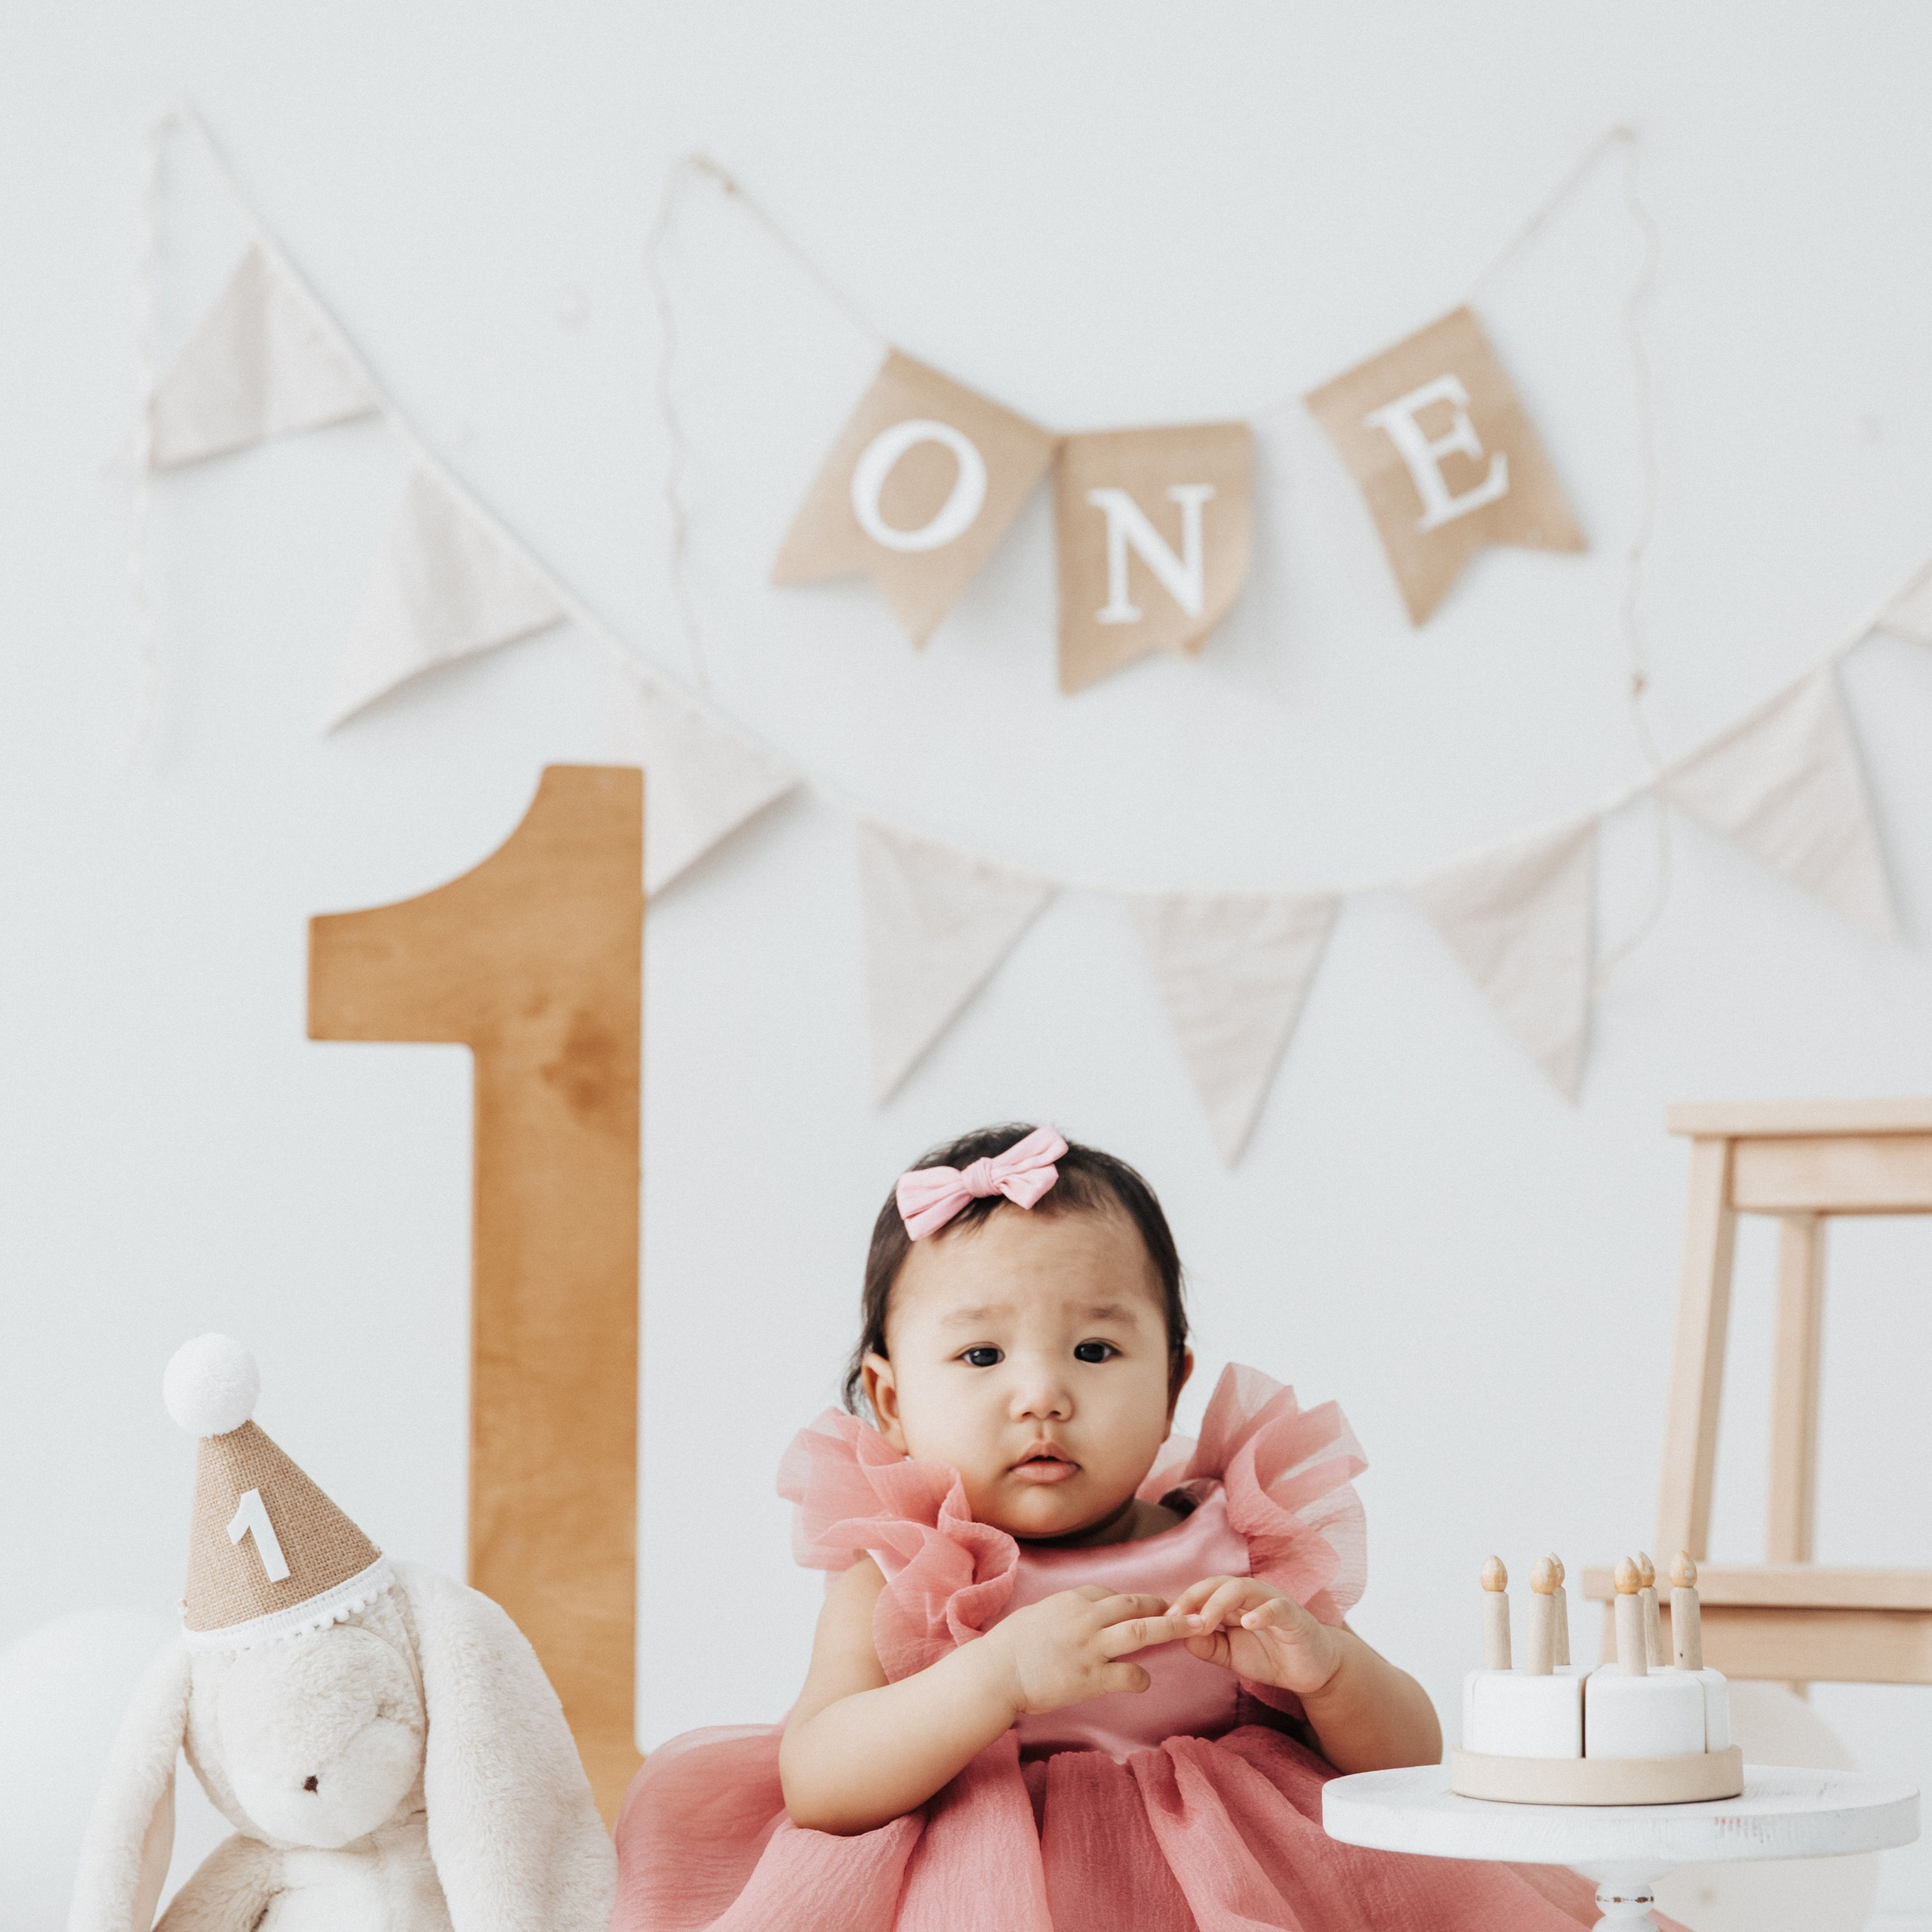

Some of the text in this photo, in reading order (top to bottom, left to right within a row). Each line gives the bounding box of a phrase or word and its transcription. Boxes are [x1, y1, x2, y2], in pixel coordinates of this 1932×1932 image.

[851, 373, 1509, 625] ONE
[307, 764, 645, 1835] 1
[226, 1487, 291, 1583] 1
